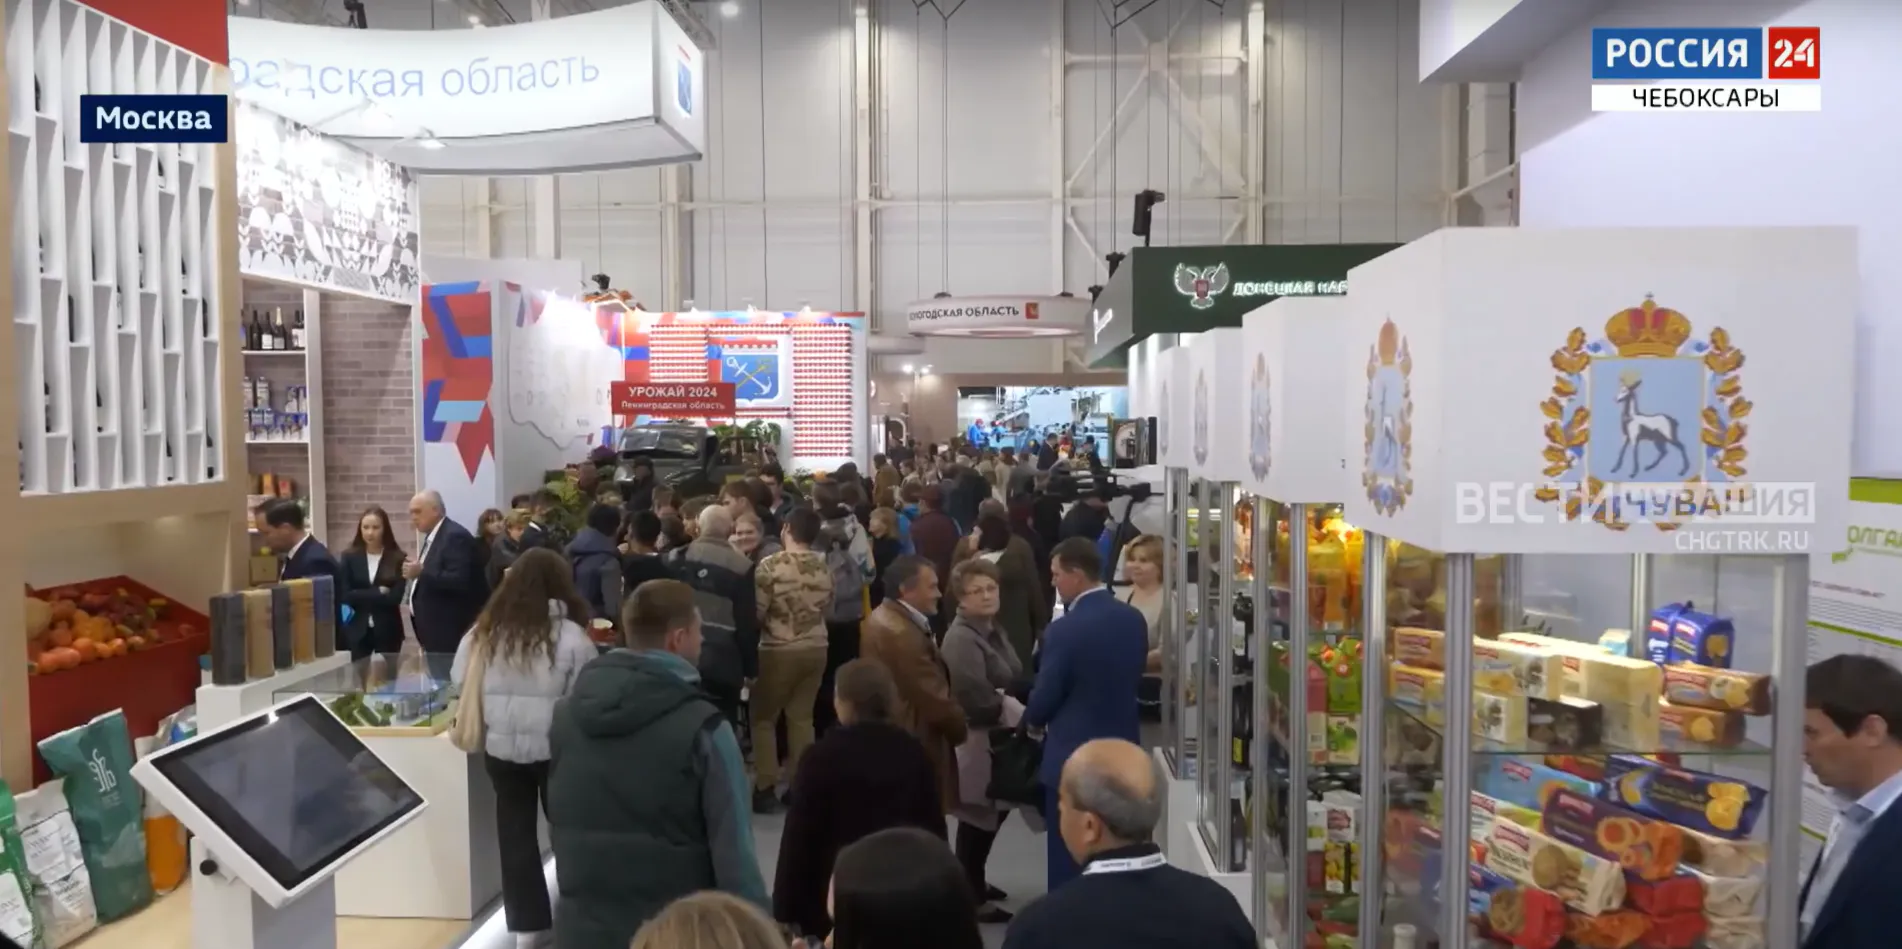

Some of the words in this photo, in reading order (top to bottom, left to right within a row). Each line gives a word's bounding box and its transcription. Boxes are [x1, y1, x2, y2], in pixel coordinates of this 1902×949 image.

[441, 57, 600, 97] область
[965, 306, 1020, 317] ОБЛАСТЬ
[628, 384, 685, 398] УРОЖАЙ
[689, 387, 718, 398] 2024
[689, 400, 725, 410] область
